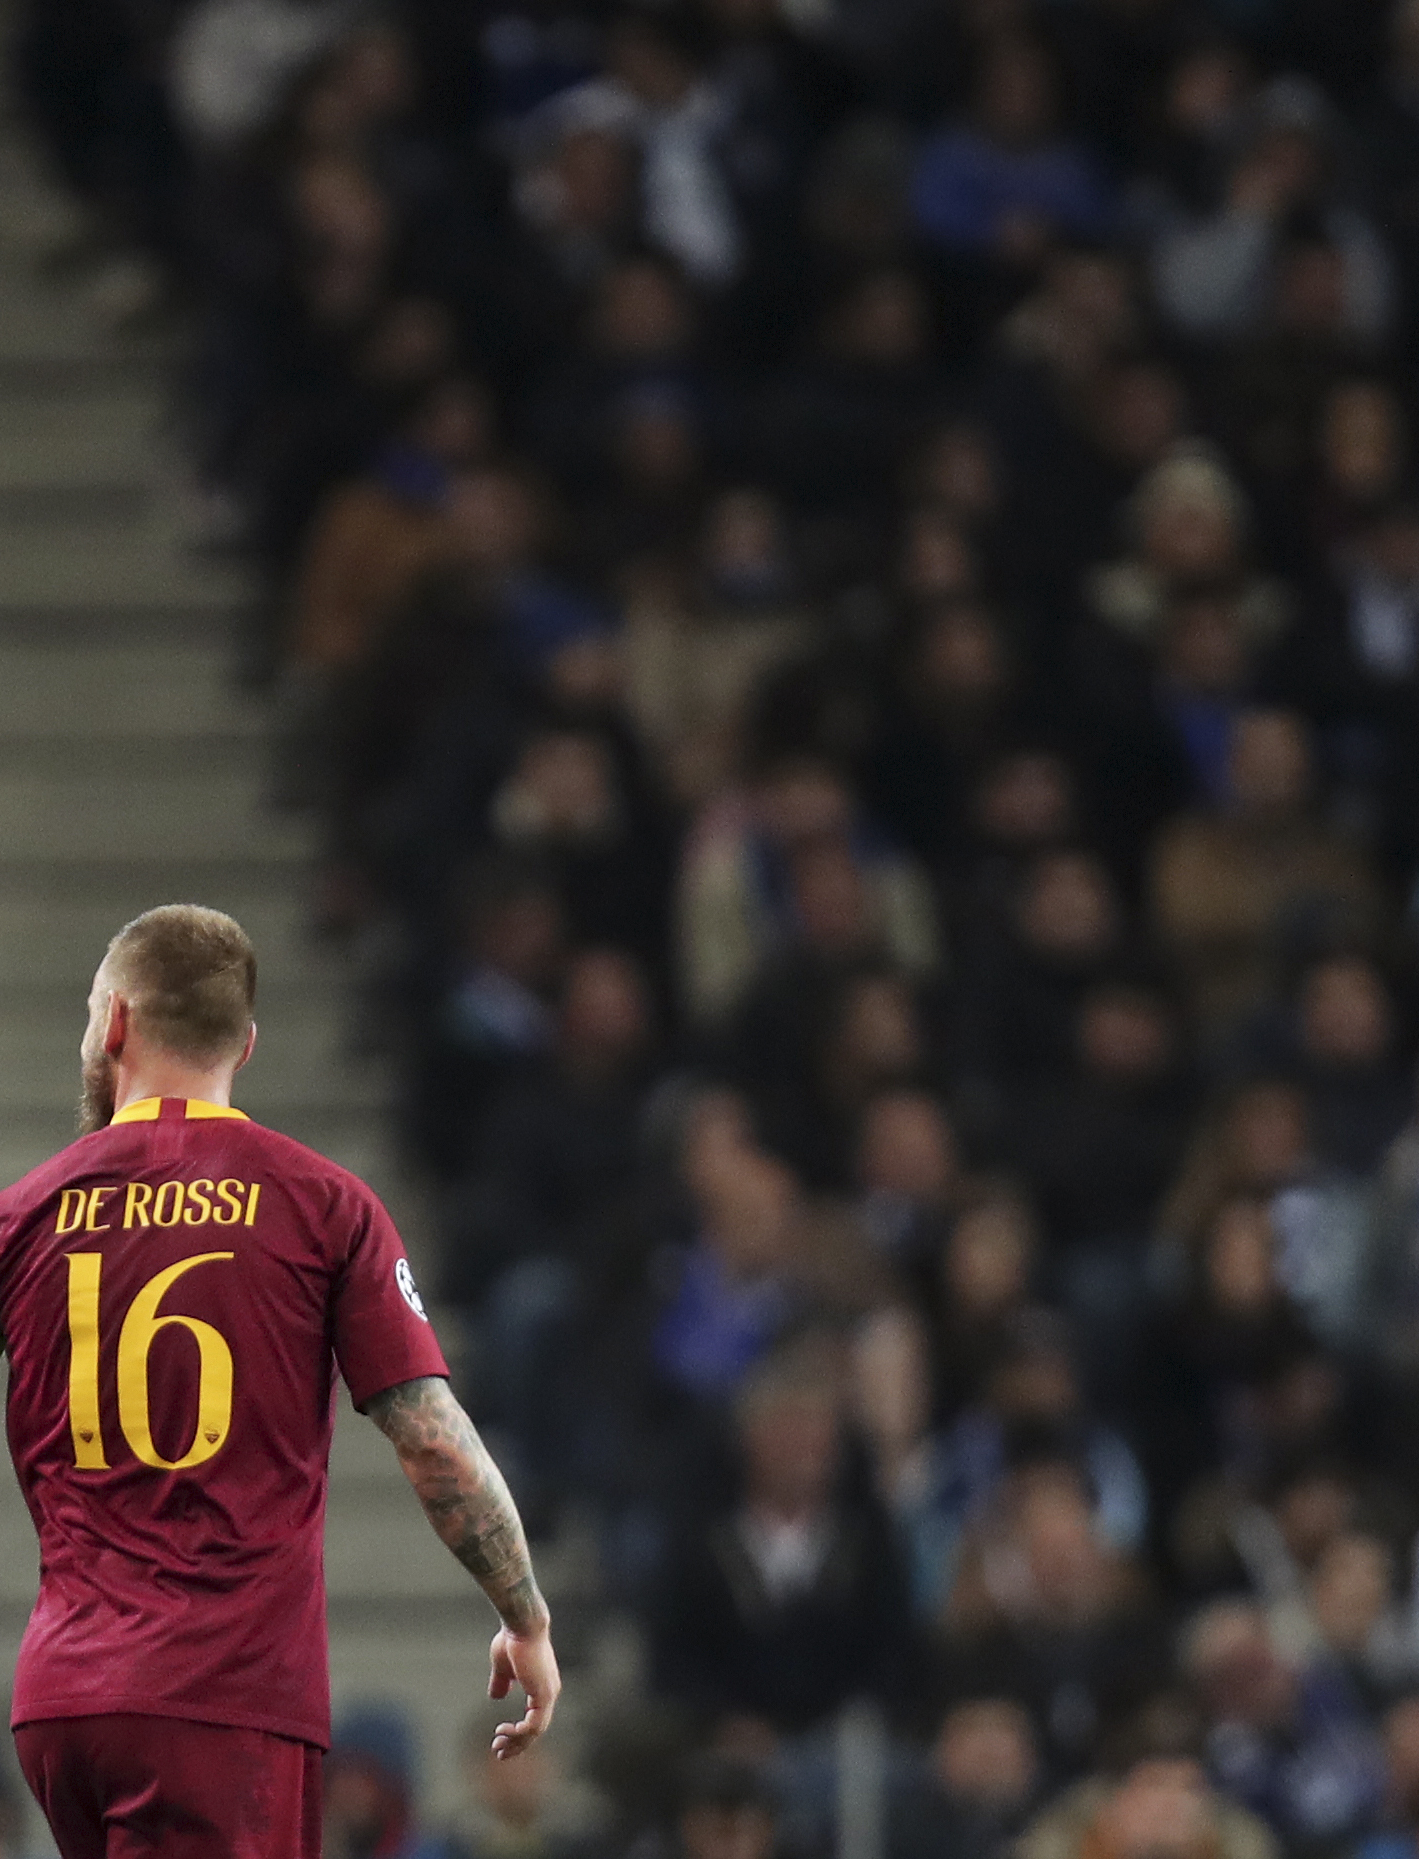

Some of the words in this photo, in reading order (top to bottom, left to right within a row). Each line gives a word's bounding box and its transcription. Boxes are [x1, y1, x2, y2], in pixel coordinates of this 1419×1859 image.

[55, 1187, 117, 1233] DE
[123, 1178, 261, 1229] ROSSI
[64, 1251, 234, 1469] 16
